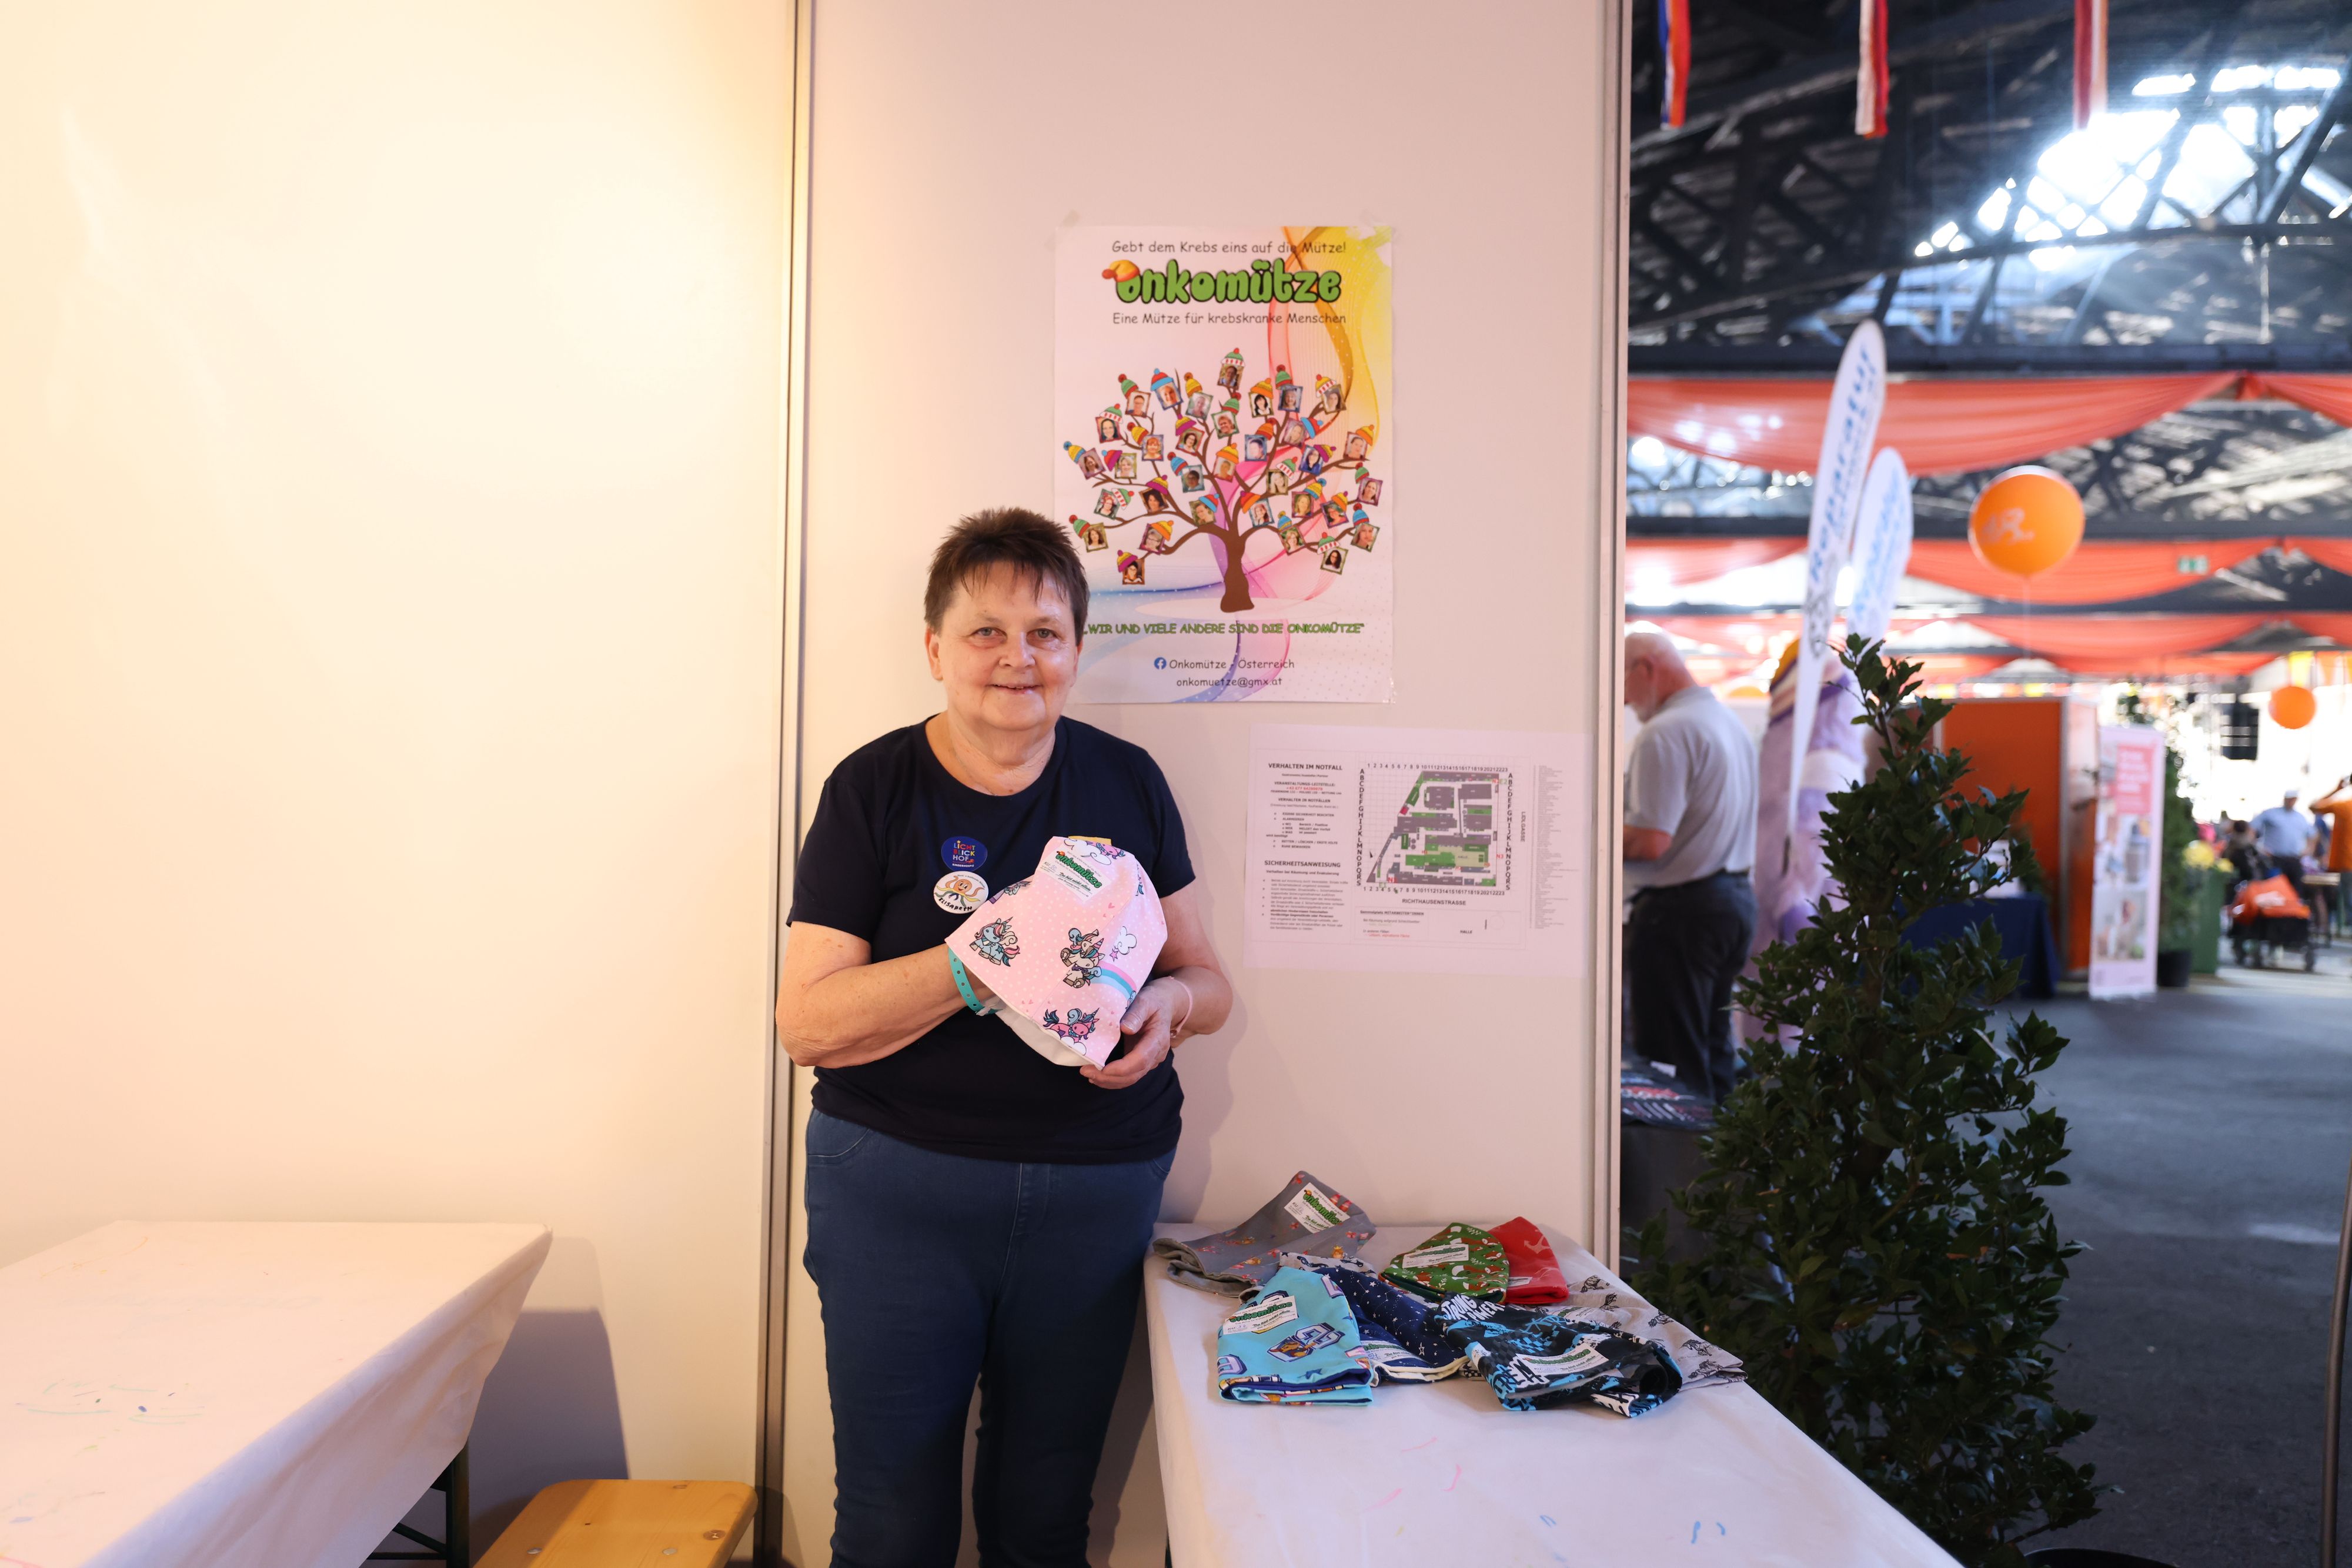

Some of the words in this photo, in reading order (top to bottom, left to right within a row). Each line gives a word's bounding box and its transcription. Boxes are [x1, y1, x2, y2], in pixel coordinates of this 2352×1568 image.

[1112, 241, 1144, 253] Gebt
[1149, 241, 1175, 253] dem
[1180, 242, 1217, 253] Krebs
[1222, 242, 1247, 253] eins
[1252, 242, 1274, 253] auf
[1277, 242, 1297, 253] die
[1302, 241, 1346, 253] Mütze!
[1113, 313, 1138, 324] Eine
[1142, 313, 1180, 324] Mütze
[1185, 312, 1204, 324] für
[1208, 312, 1282, 324] krebskranke
[1287, 313, 1346, 324] Menschen
[1115, 624, 1140, 634] UND
[1144, 623, 1177, 634] VIELE
[1180, 623, 1225, 634] ANDERE
[1228, 623, 1259, 634] SIND
[1262, 623, 1284, 633] DIE
[1169, 659, 1227, 669] Onkomütze
[1238, 658, 1295, 668] Österreich
[1177, 677, 1282, 688] onkomuetze@gmx.at
[954, 840, 975, 850] LICHT
[938, 897, 973, 911] ELISABETH
